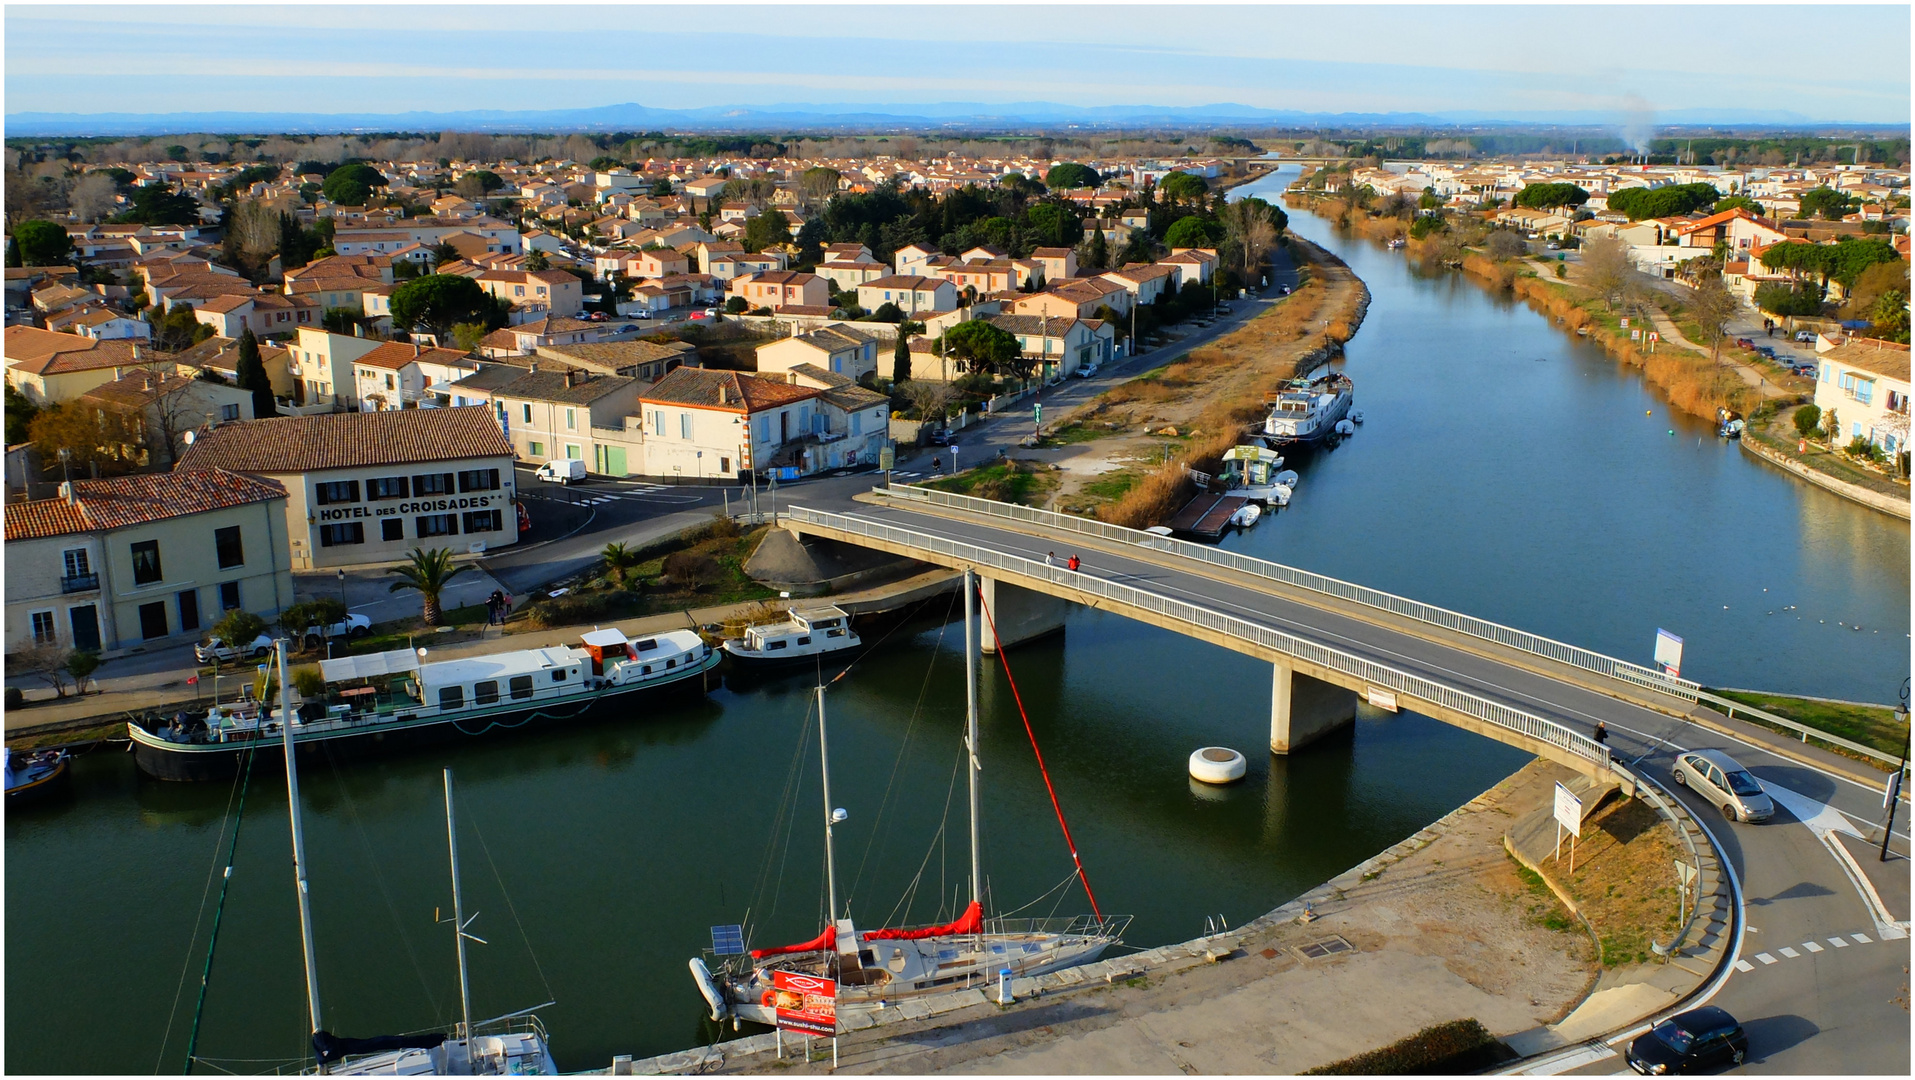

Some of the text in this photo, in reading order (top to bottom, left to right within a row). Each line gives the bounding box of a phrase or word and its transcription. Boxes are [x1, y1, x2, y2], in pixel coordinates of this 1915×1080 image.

[320, 496, 490, 520] HOTEL DES CROISADES
